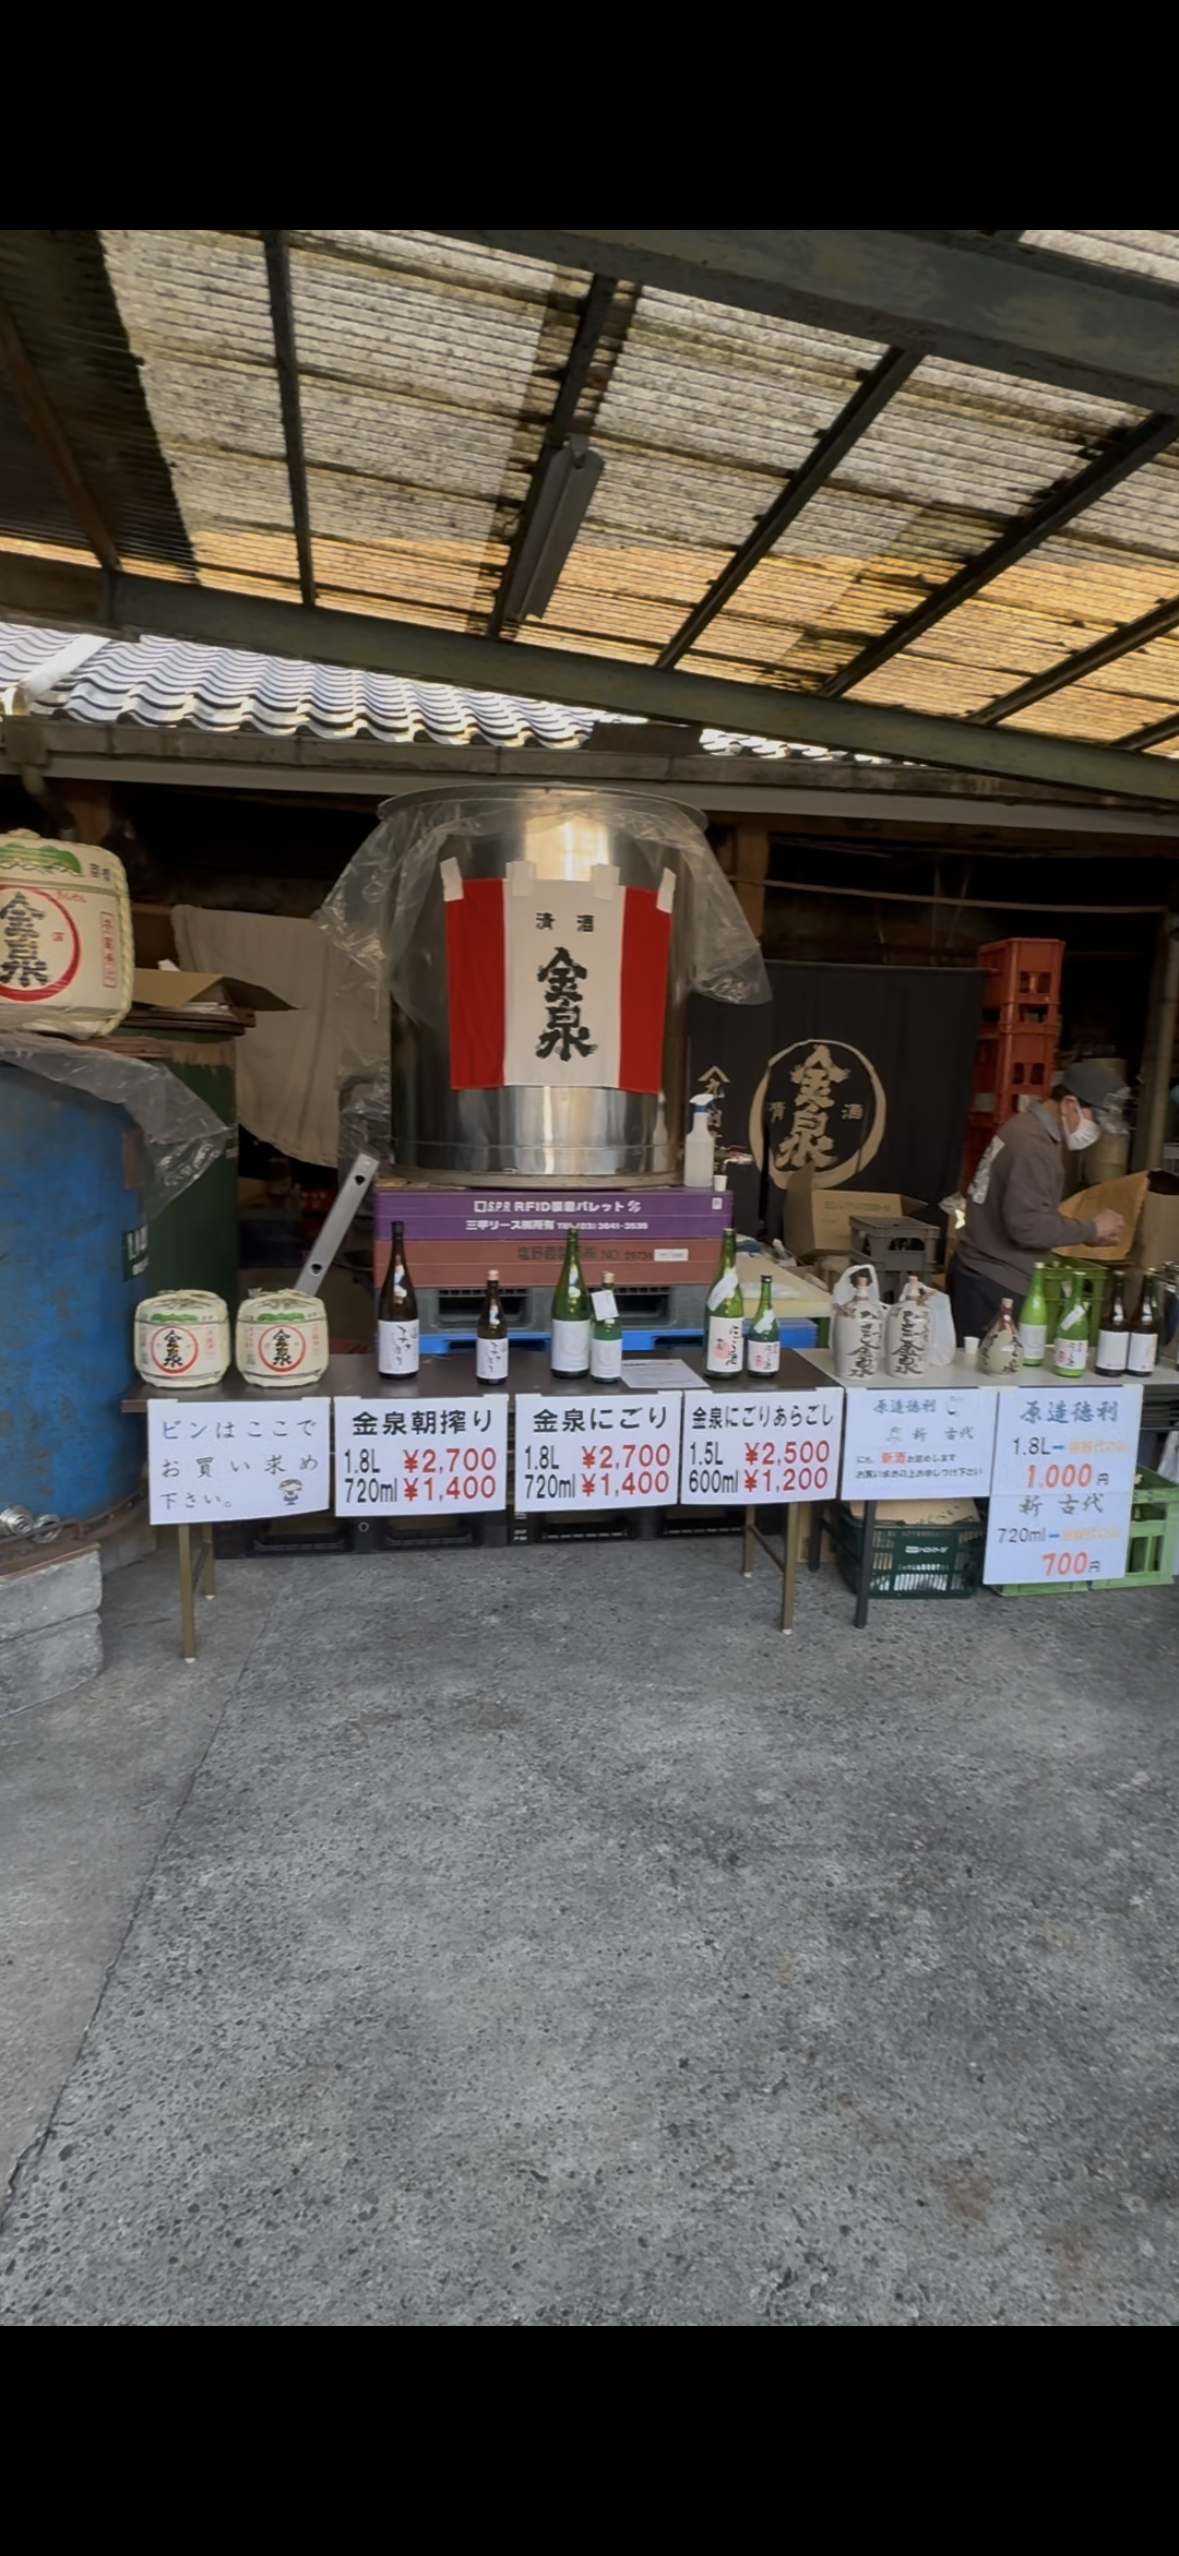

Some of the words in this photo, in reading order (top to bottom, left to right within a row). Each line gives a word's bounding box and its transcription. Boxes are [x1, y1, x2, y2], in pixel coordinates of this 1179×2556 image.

[535, 946, 598, 1062] 金泉
[774, 1042, 852, 1169] 金泉
[162, 1419, 317, 1440] ビンはここで
[352, 1410, 492, 1435] 金泉朝搾り
[533, 1406, 667, 1433] 金泉にごり
[692, 1404, 834, 1429] 金泉にごりあらごし
[525, 1445, 560, 1470] 1.8L
[581, 1443, 671, 1469] ¥2,700
[690, 1441, 724, 1466] 1.5L
[745, 1440, 830, 1466] ¥2,500
[1013, 1437, 1051, 1456] 1.8L
[161, 1454, 318, 1478] お買い求め
[344, 1448, 380, 1474] 1.8L
[403, 1447, 497, 1473] ¥2,700
[344, 1478, 398, 1503] 720ml
[403, 1475, 496, 1502] ¥1,400
[524, 1474, 576, 1499] 720ml
[581, 1470, 669, 1496] ¥1,400
[689, 1469, 739, 1493] 600ml
[744, 1467, 828, 1492] ¥1,200
[997, 1527, 1047, 1543] 720ml
